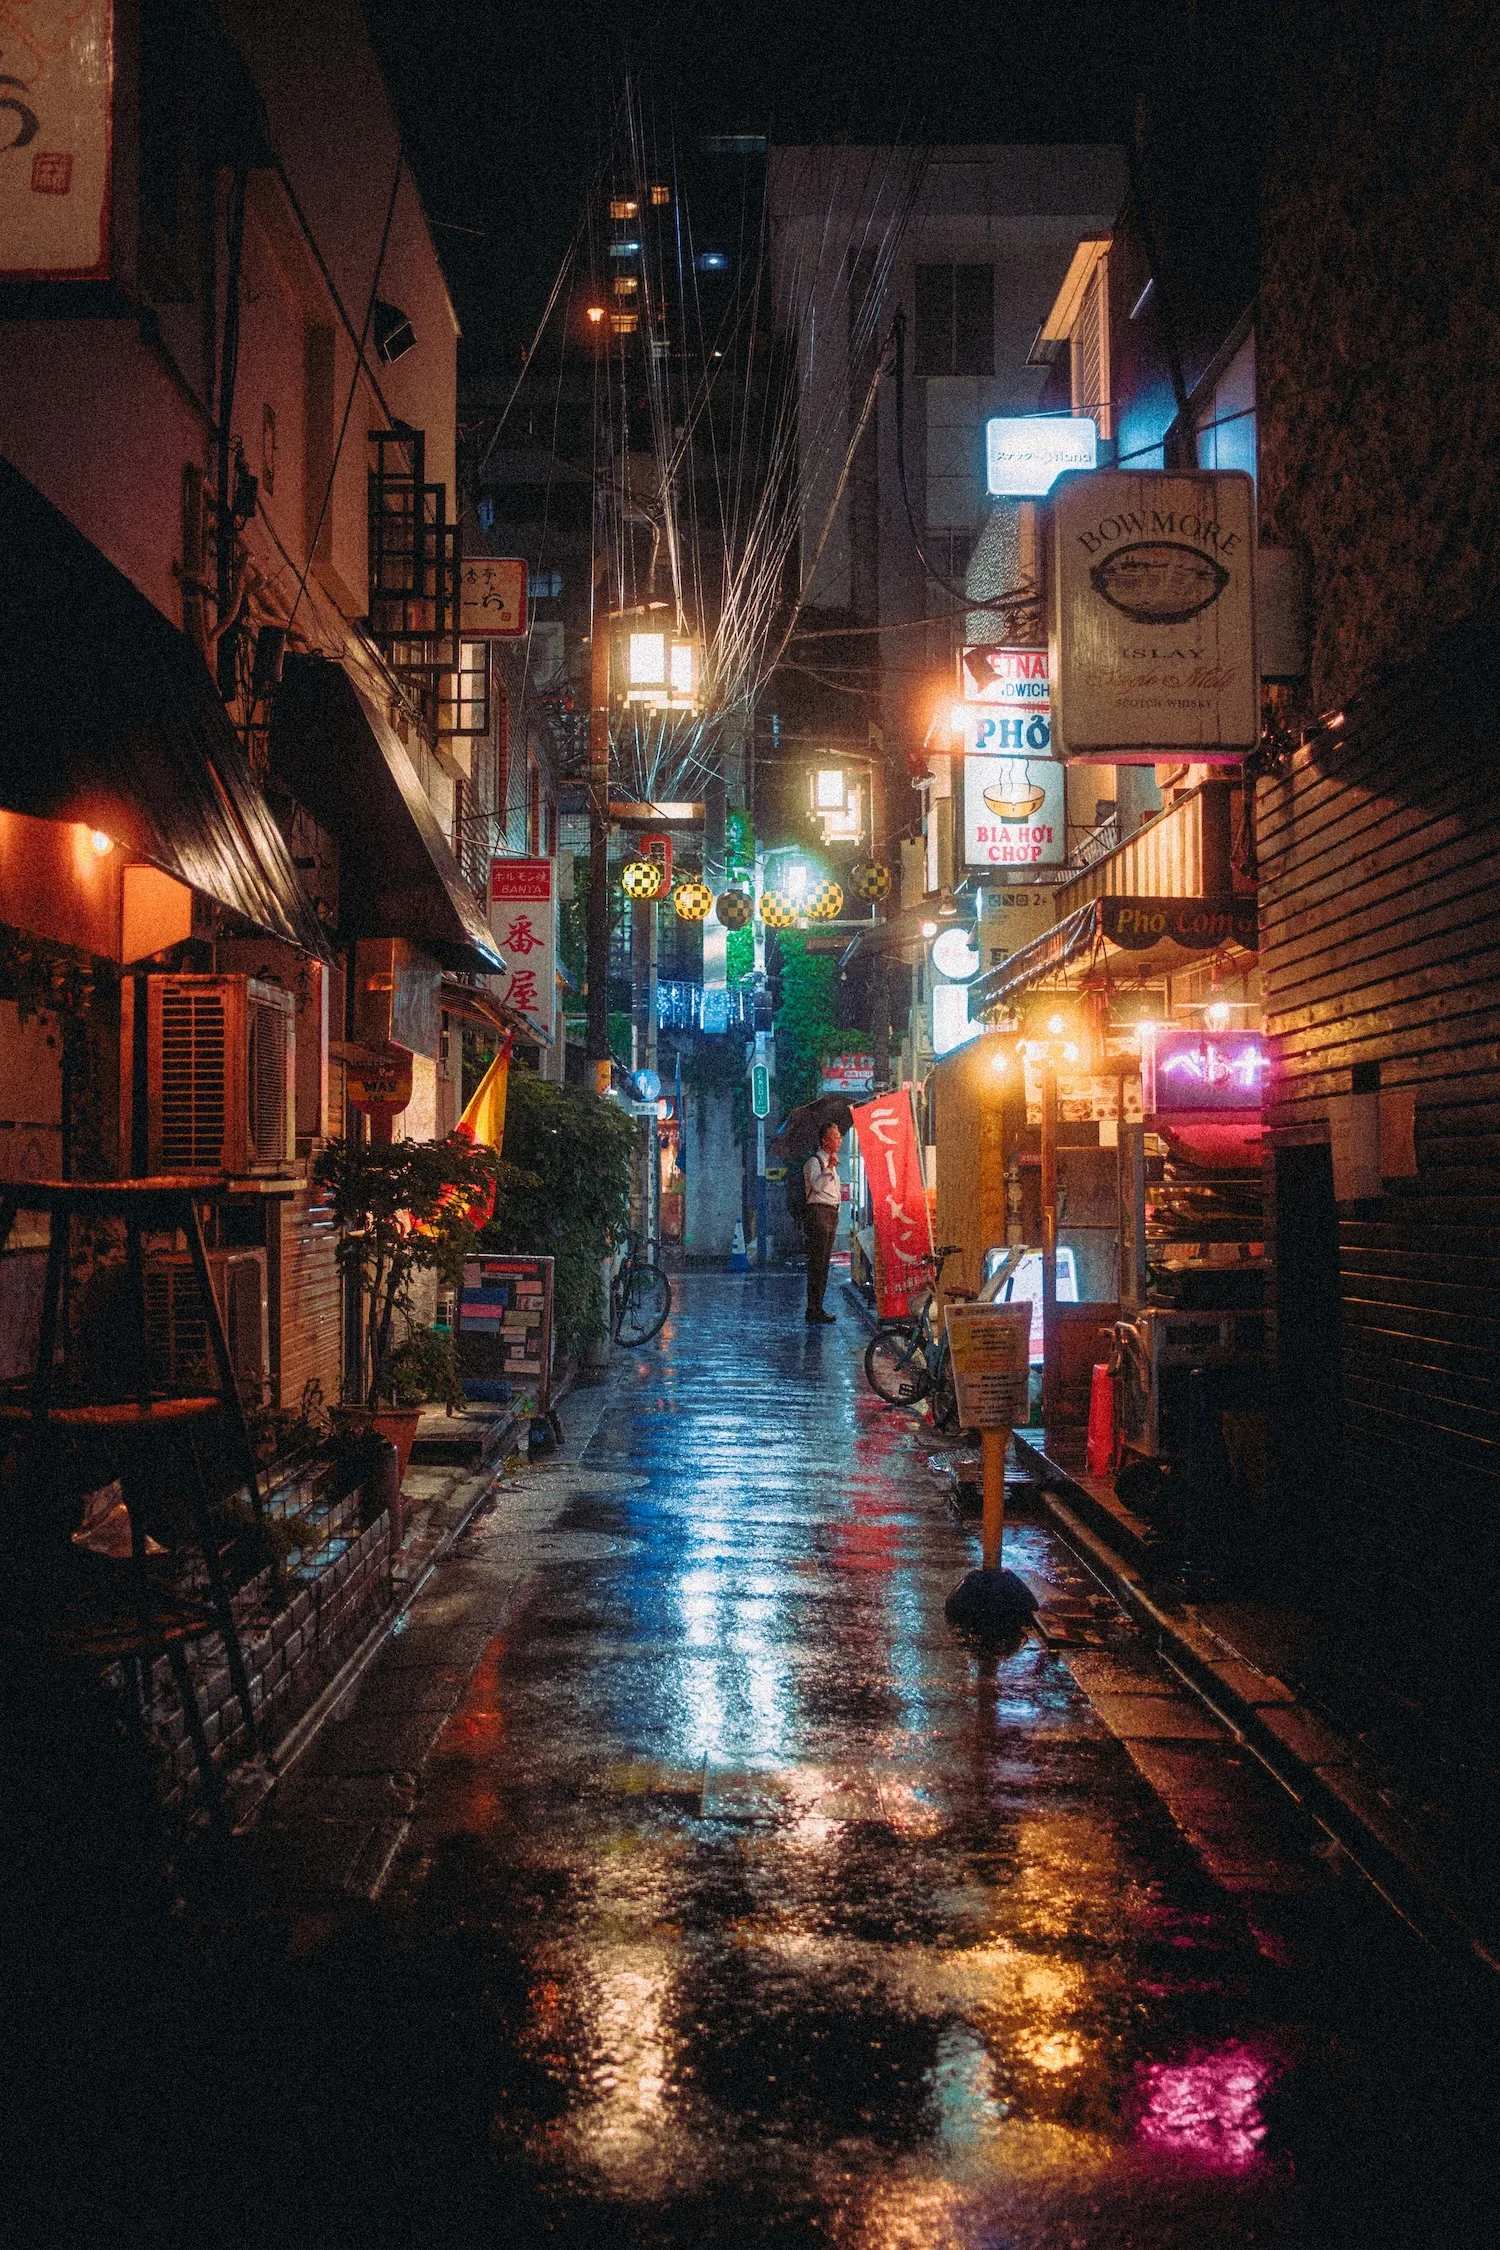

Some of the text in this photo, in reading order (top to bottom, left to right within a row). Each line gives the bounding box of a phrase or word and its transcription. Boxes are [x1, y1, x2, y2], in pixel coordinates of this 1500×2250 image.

[1076, 510, 1242, 556] BOWMORE
[1121, 648, 1206, 659] ISLAY
[988, 654, 1049, 679] ETNA
[1001, 683, 1050, 697] DWICH
[1116, 698, 1212, 709] SCOTCH WHISKY
[977, 826, 1011, 843] BIA
[494, 871, 549, 883] ホルモン焼
[501, 884, 543, 895] BANYA
[499, 914, 545, 1012] 番屋
[869, 1107, 917, 1264] ラーメン
